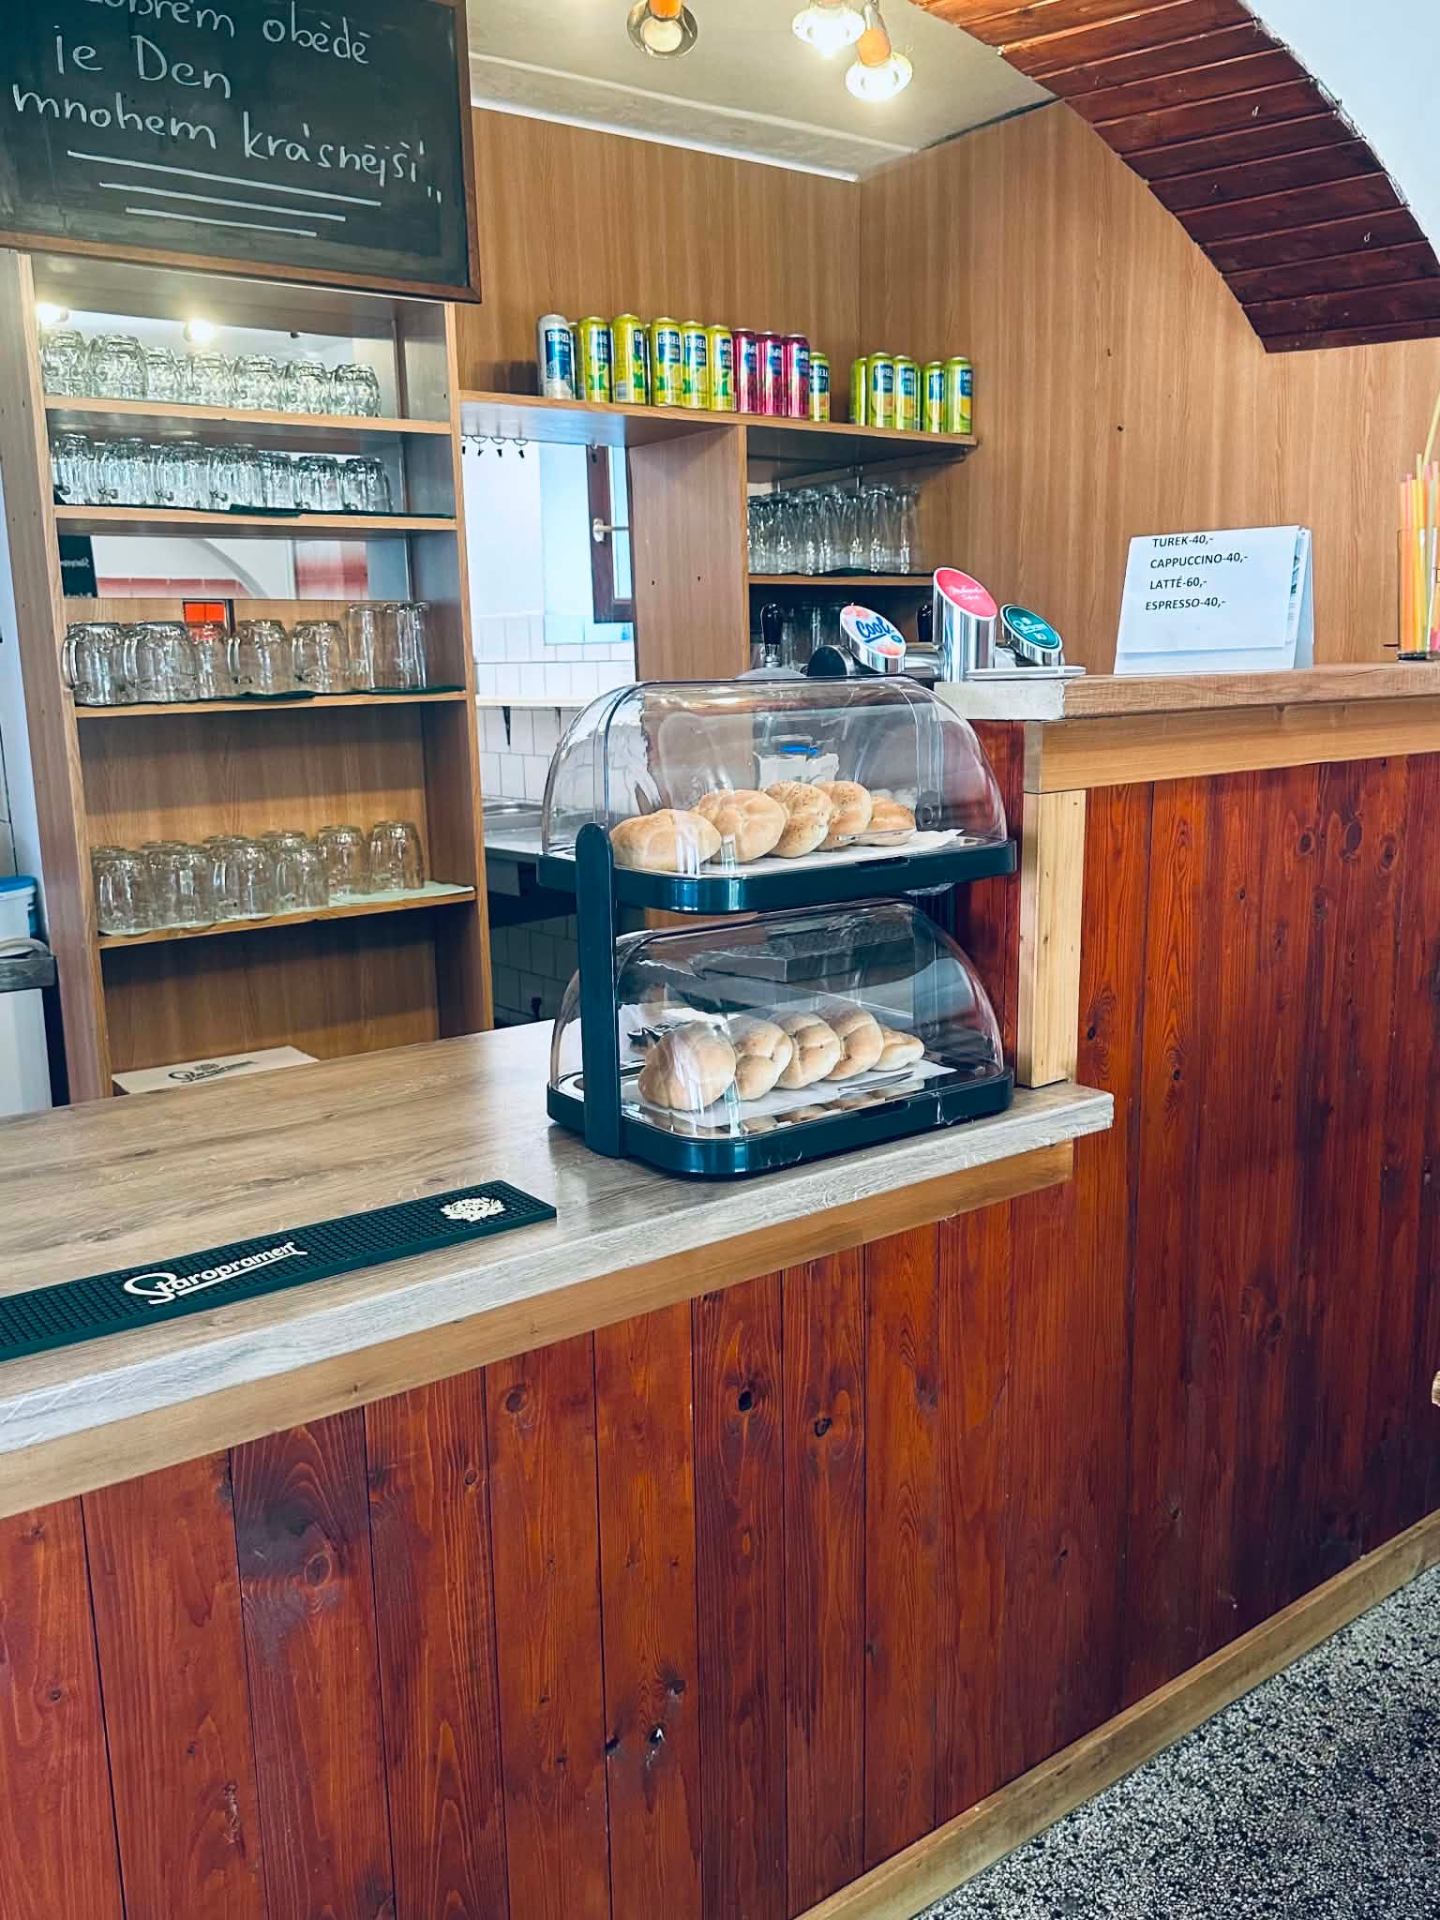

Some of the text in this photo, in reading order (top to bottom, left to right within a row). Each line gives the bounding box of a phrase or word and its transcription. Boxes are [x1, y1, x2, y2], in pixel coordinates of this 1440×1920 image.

[130, 34, 231, 99] Den
[12, 84, 217, 149] mnohem
[1152, 535, 1214, 548] TUREK-40,-
[1150, 552, 1248, 569] CAPPUCCINO-40,-
[1150, 575, 1207, 590] LATTÉ-60,-
[1145, 597, 1226, 611] ESPRESSO-40,-
[122, 1241, 307, 1305] Staropramen
